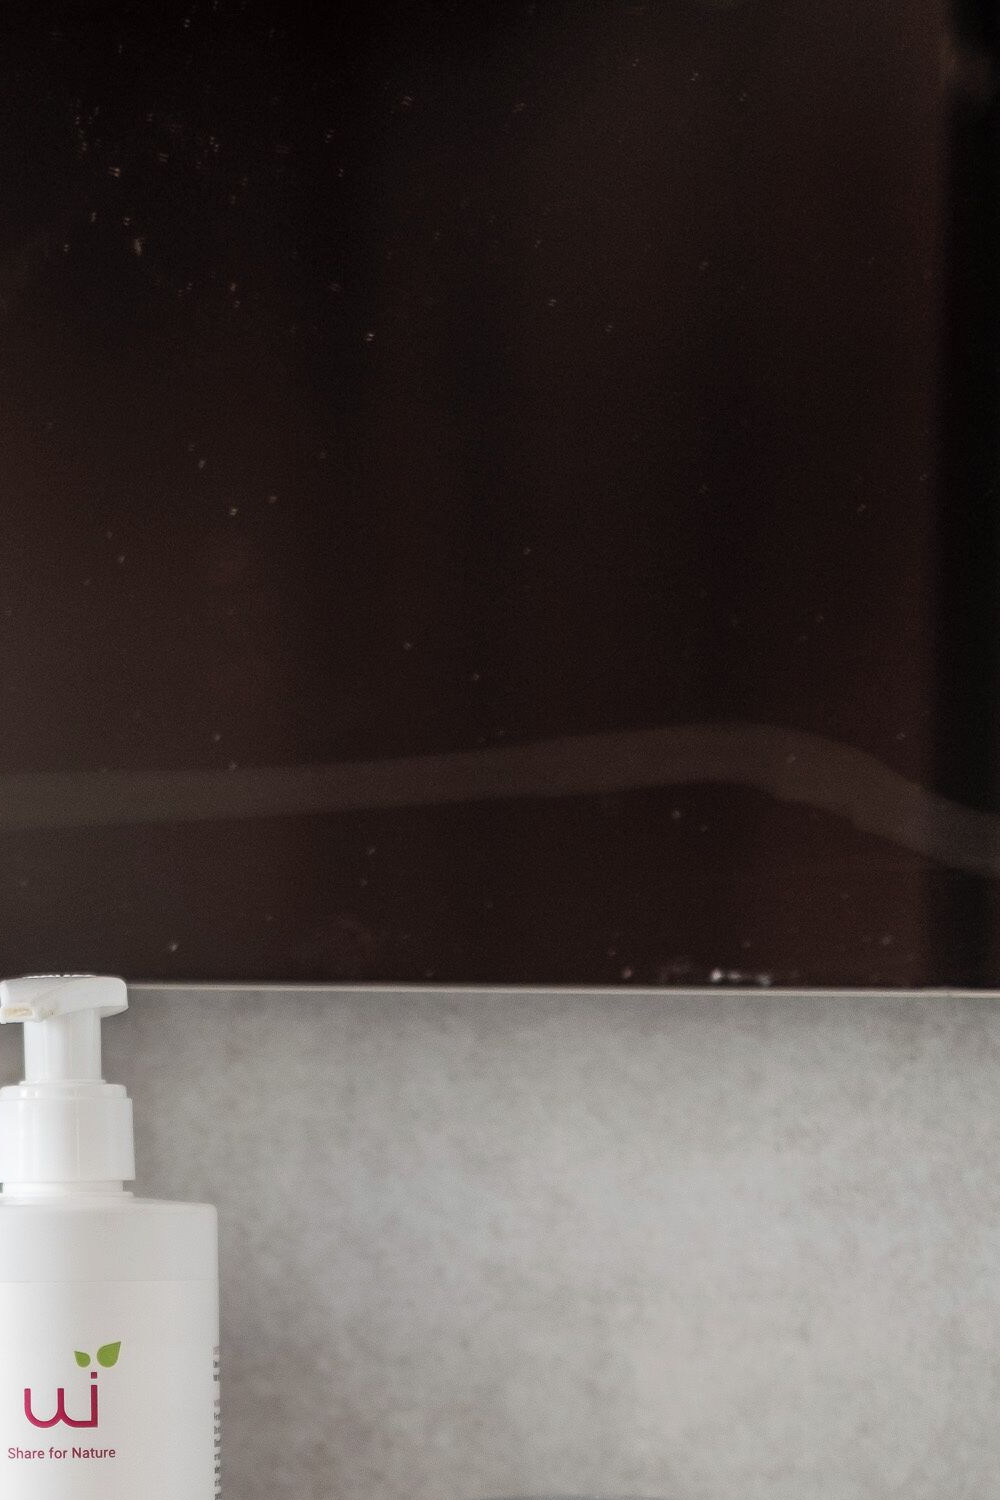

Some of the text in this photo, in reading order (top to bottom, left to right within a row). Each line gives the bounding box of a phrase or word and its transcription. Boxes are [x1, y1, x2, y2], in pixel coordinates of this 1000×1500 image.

[7, 1446, 117, 1460] Share for Nature
